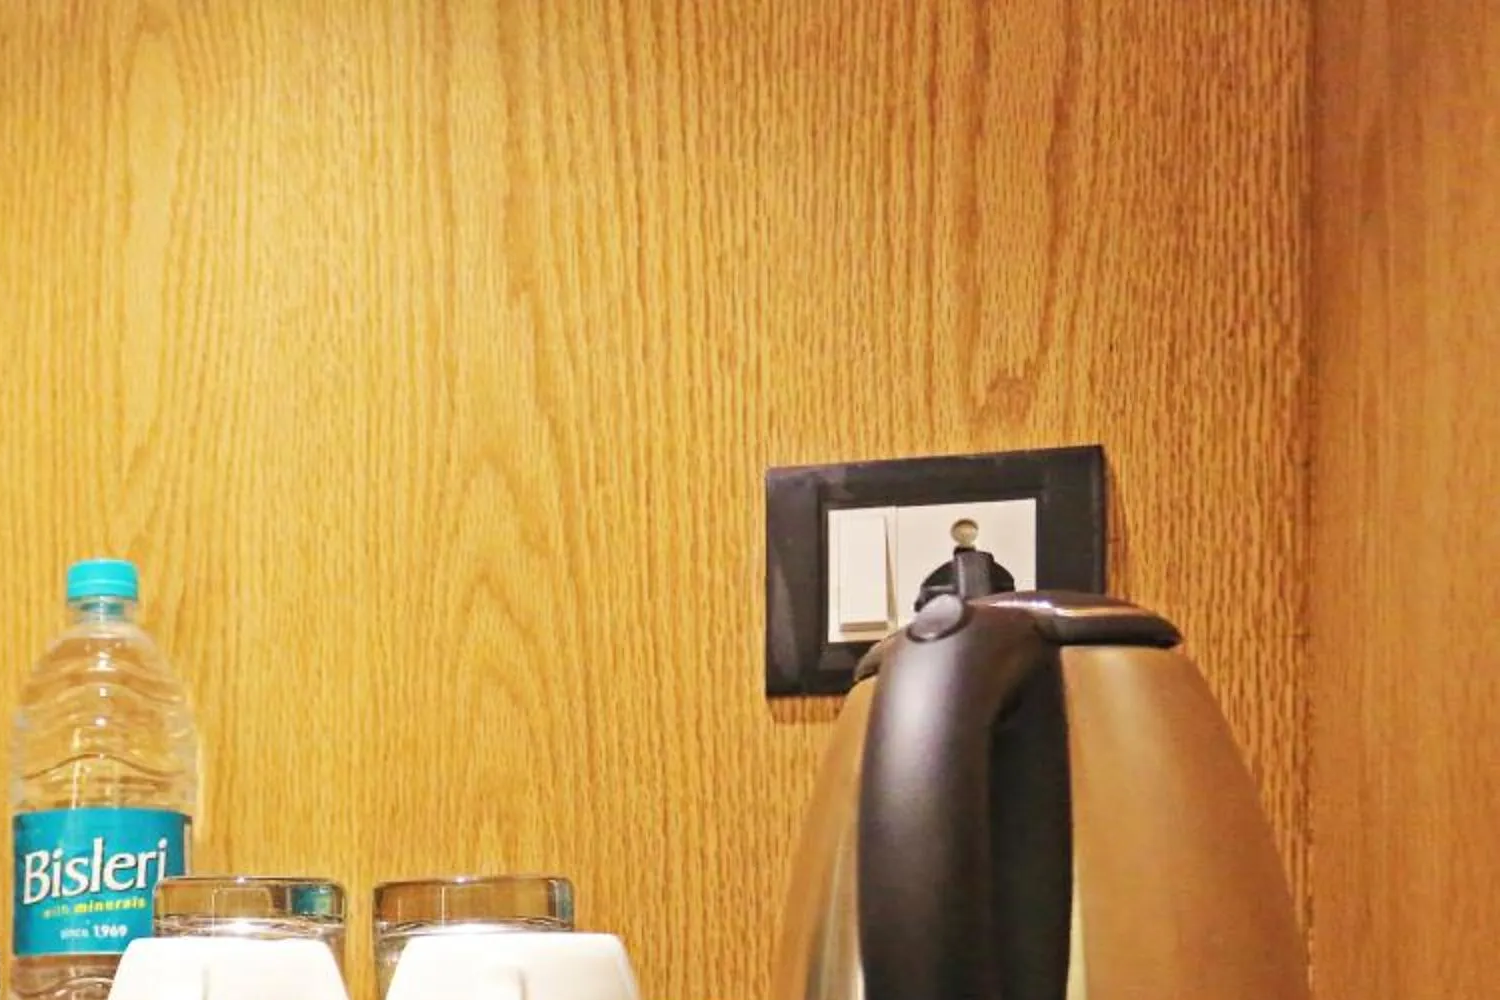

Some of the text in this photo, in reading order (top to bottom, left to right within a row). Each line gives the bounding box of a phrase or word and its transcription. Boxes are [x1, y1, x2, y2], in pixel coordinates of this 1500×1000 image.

[22, 836, 169, 905] Bisleri
[73, 895, 146, 914] minerals
[92, 923, 130, 938] 1969
